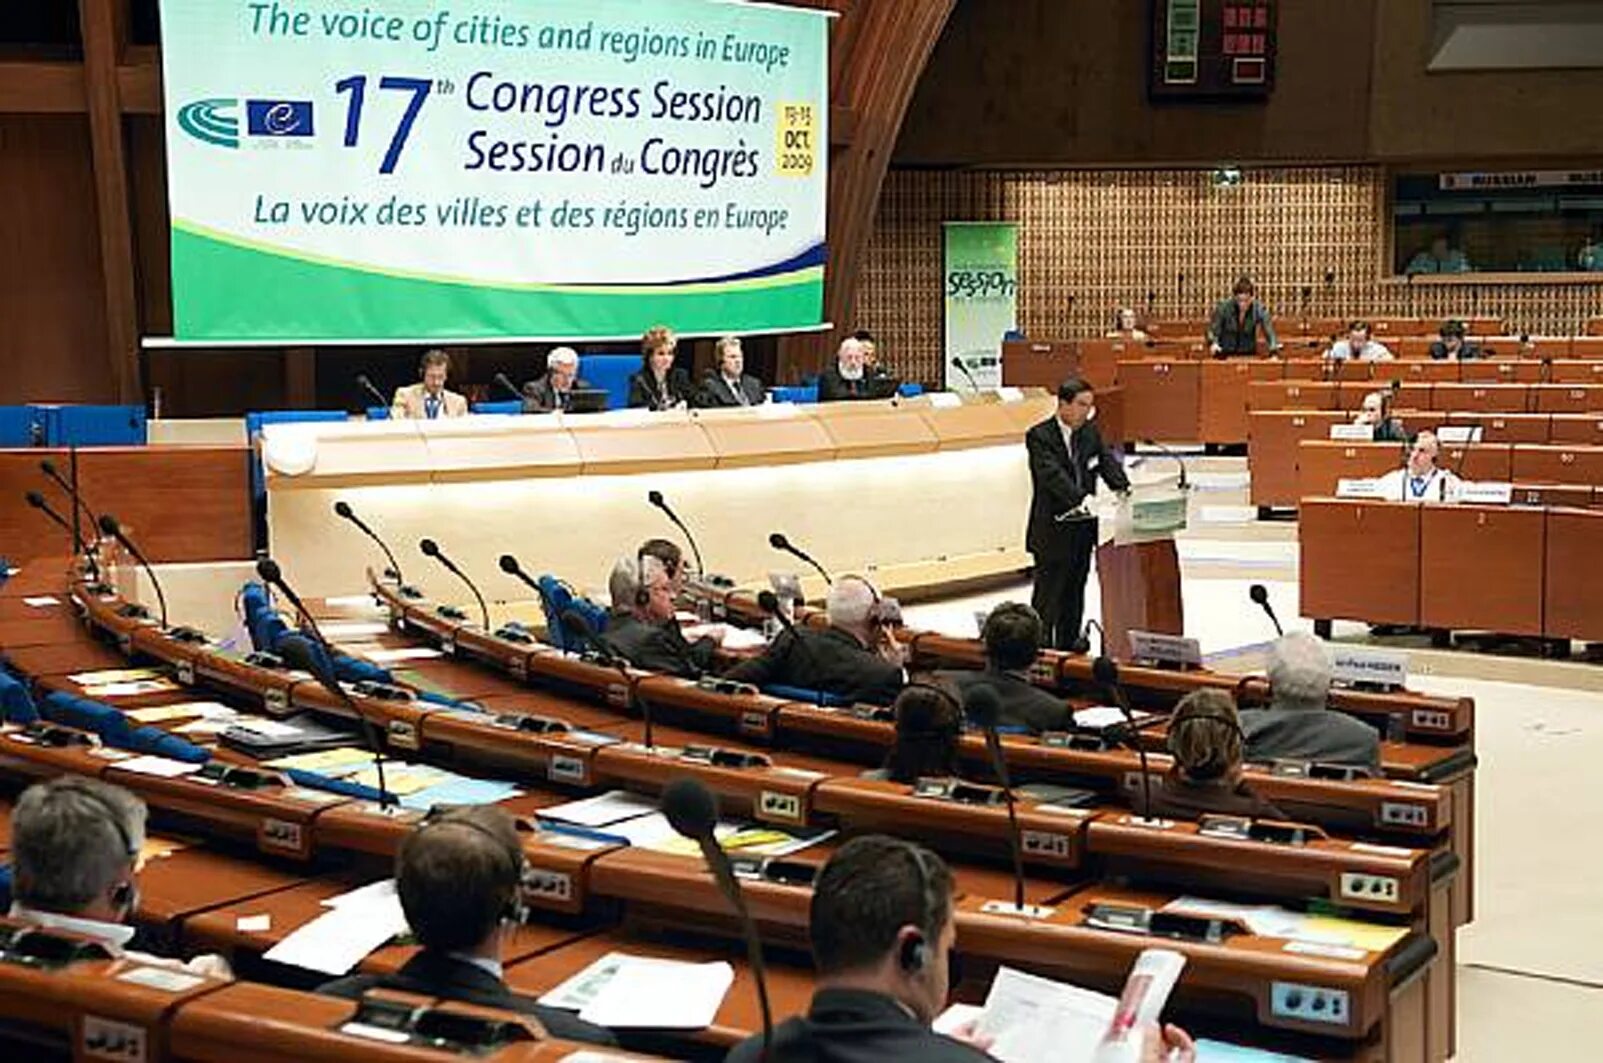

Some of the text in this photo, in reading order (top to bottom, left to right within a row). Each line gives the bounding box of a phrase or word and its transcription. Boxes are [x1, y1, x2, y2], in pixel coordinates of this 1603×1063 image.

[250, 2, 790, 71] The voice of cities and regions in Europe
[335, 71, 761, 174] 17 th Congress Session
[784, 130, 811, 149] OCT
[465, 131, 759, 188] Session du Congrès
[781, 154, 813, 175] 2009
[254, 195, 789, 236] La voix des villes et des régions en Europe
